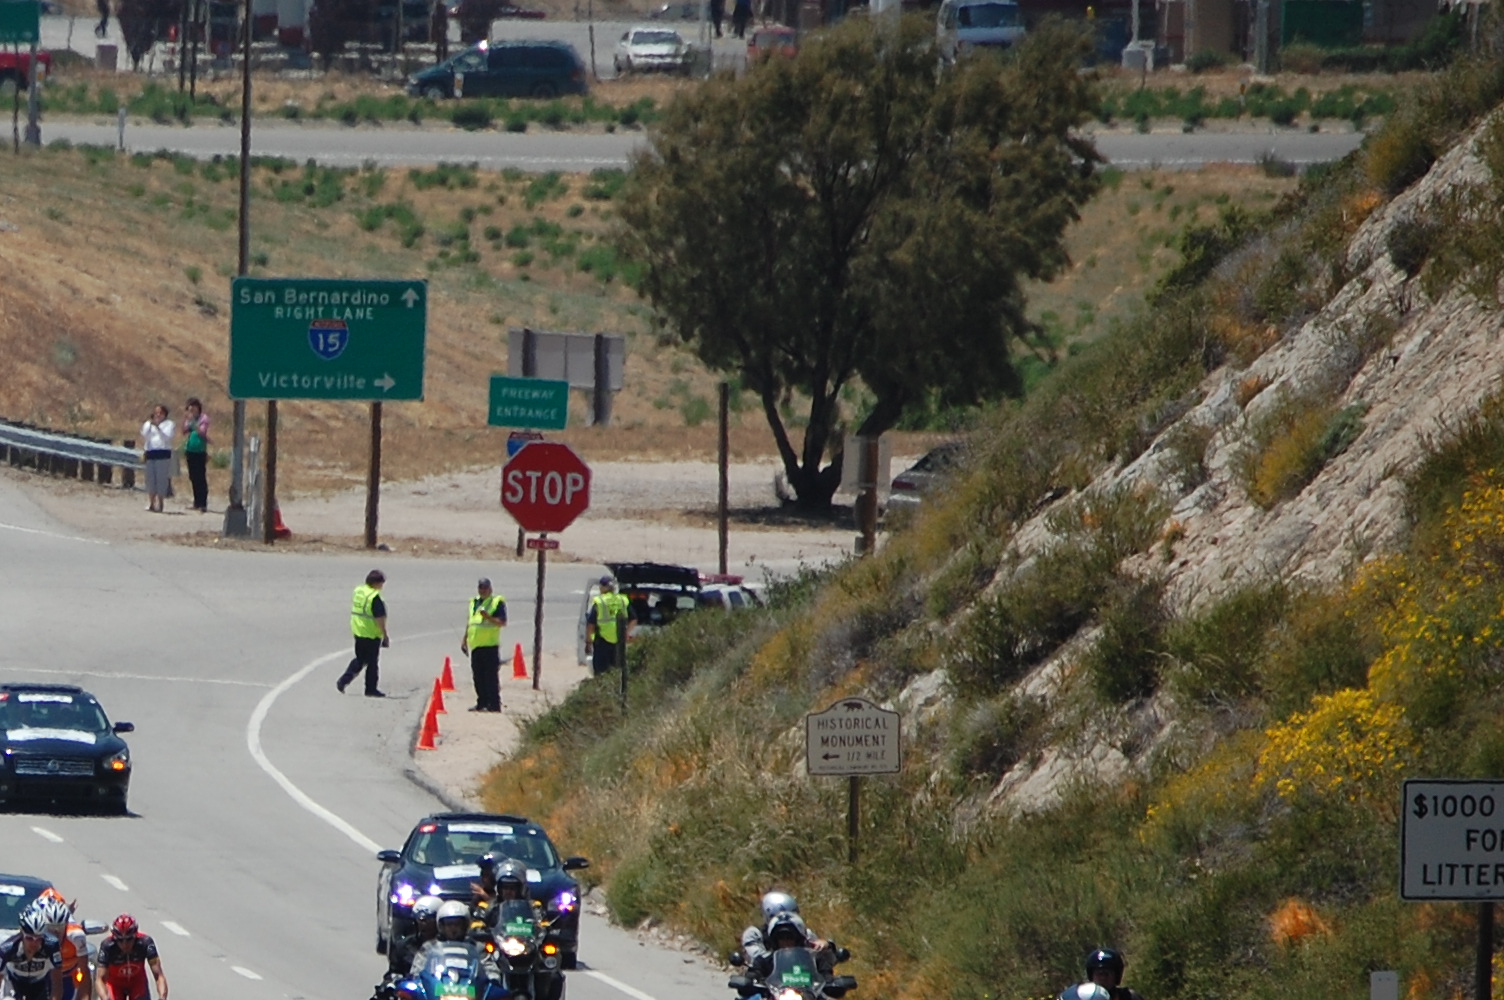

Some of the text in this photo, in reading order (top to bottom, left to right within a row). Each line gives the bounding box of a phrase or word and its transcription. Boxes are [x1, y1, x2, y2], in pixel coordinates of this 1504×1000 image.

[240, 288, 390, 305] San Bernardino
[274, 306, 374, 320] RIGHT LANE
[318, 333, 340, 352] 15
[258, 373, 366, 389] Victorville
[501, 387, 556, 400] FREEWAY
[496, 407, 558, 420] ENTRANCE
[504, 470, 584, 505] STOP
[817, 717, 888, 730] HISTORICAL
[821, 735, 886, 747] MONUMENT
[847, 751, 885, 761] 1/2 MILE
[1413, 793, 1495, 819] $1000
[1466, 828, 1504, 852] FO
[1422, 864, 1504, 885] LITTER
[782, 975, 809, 983] Photo
